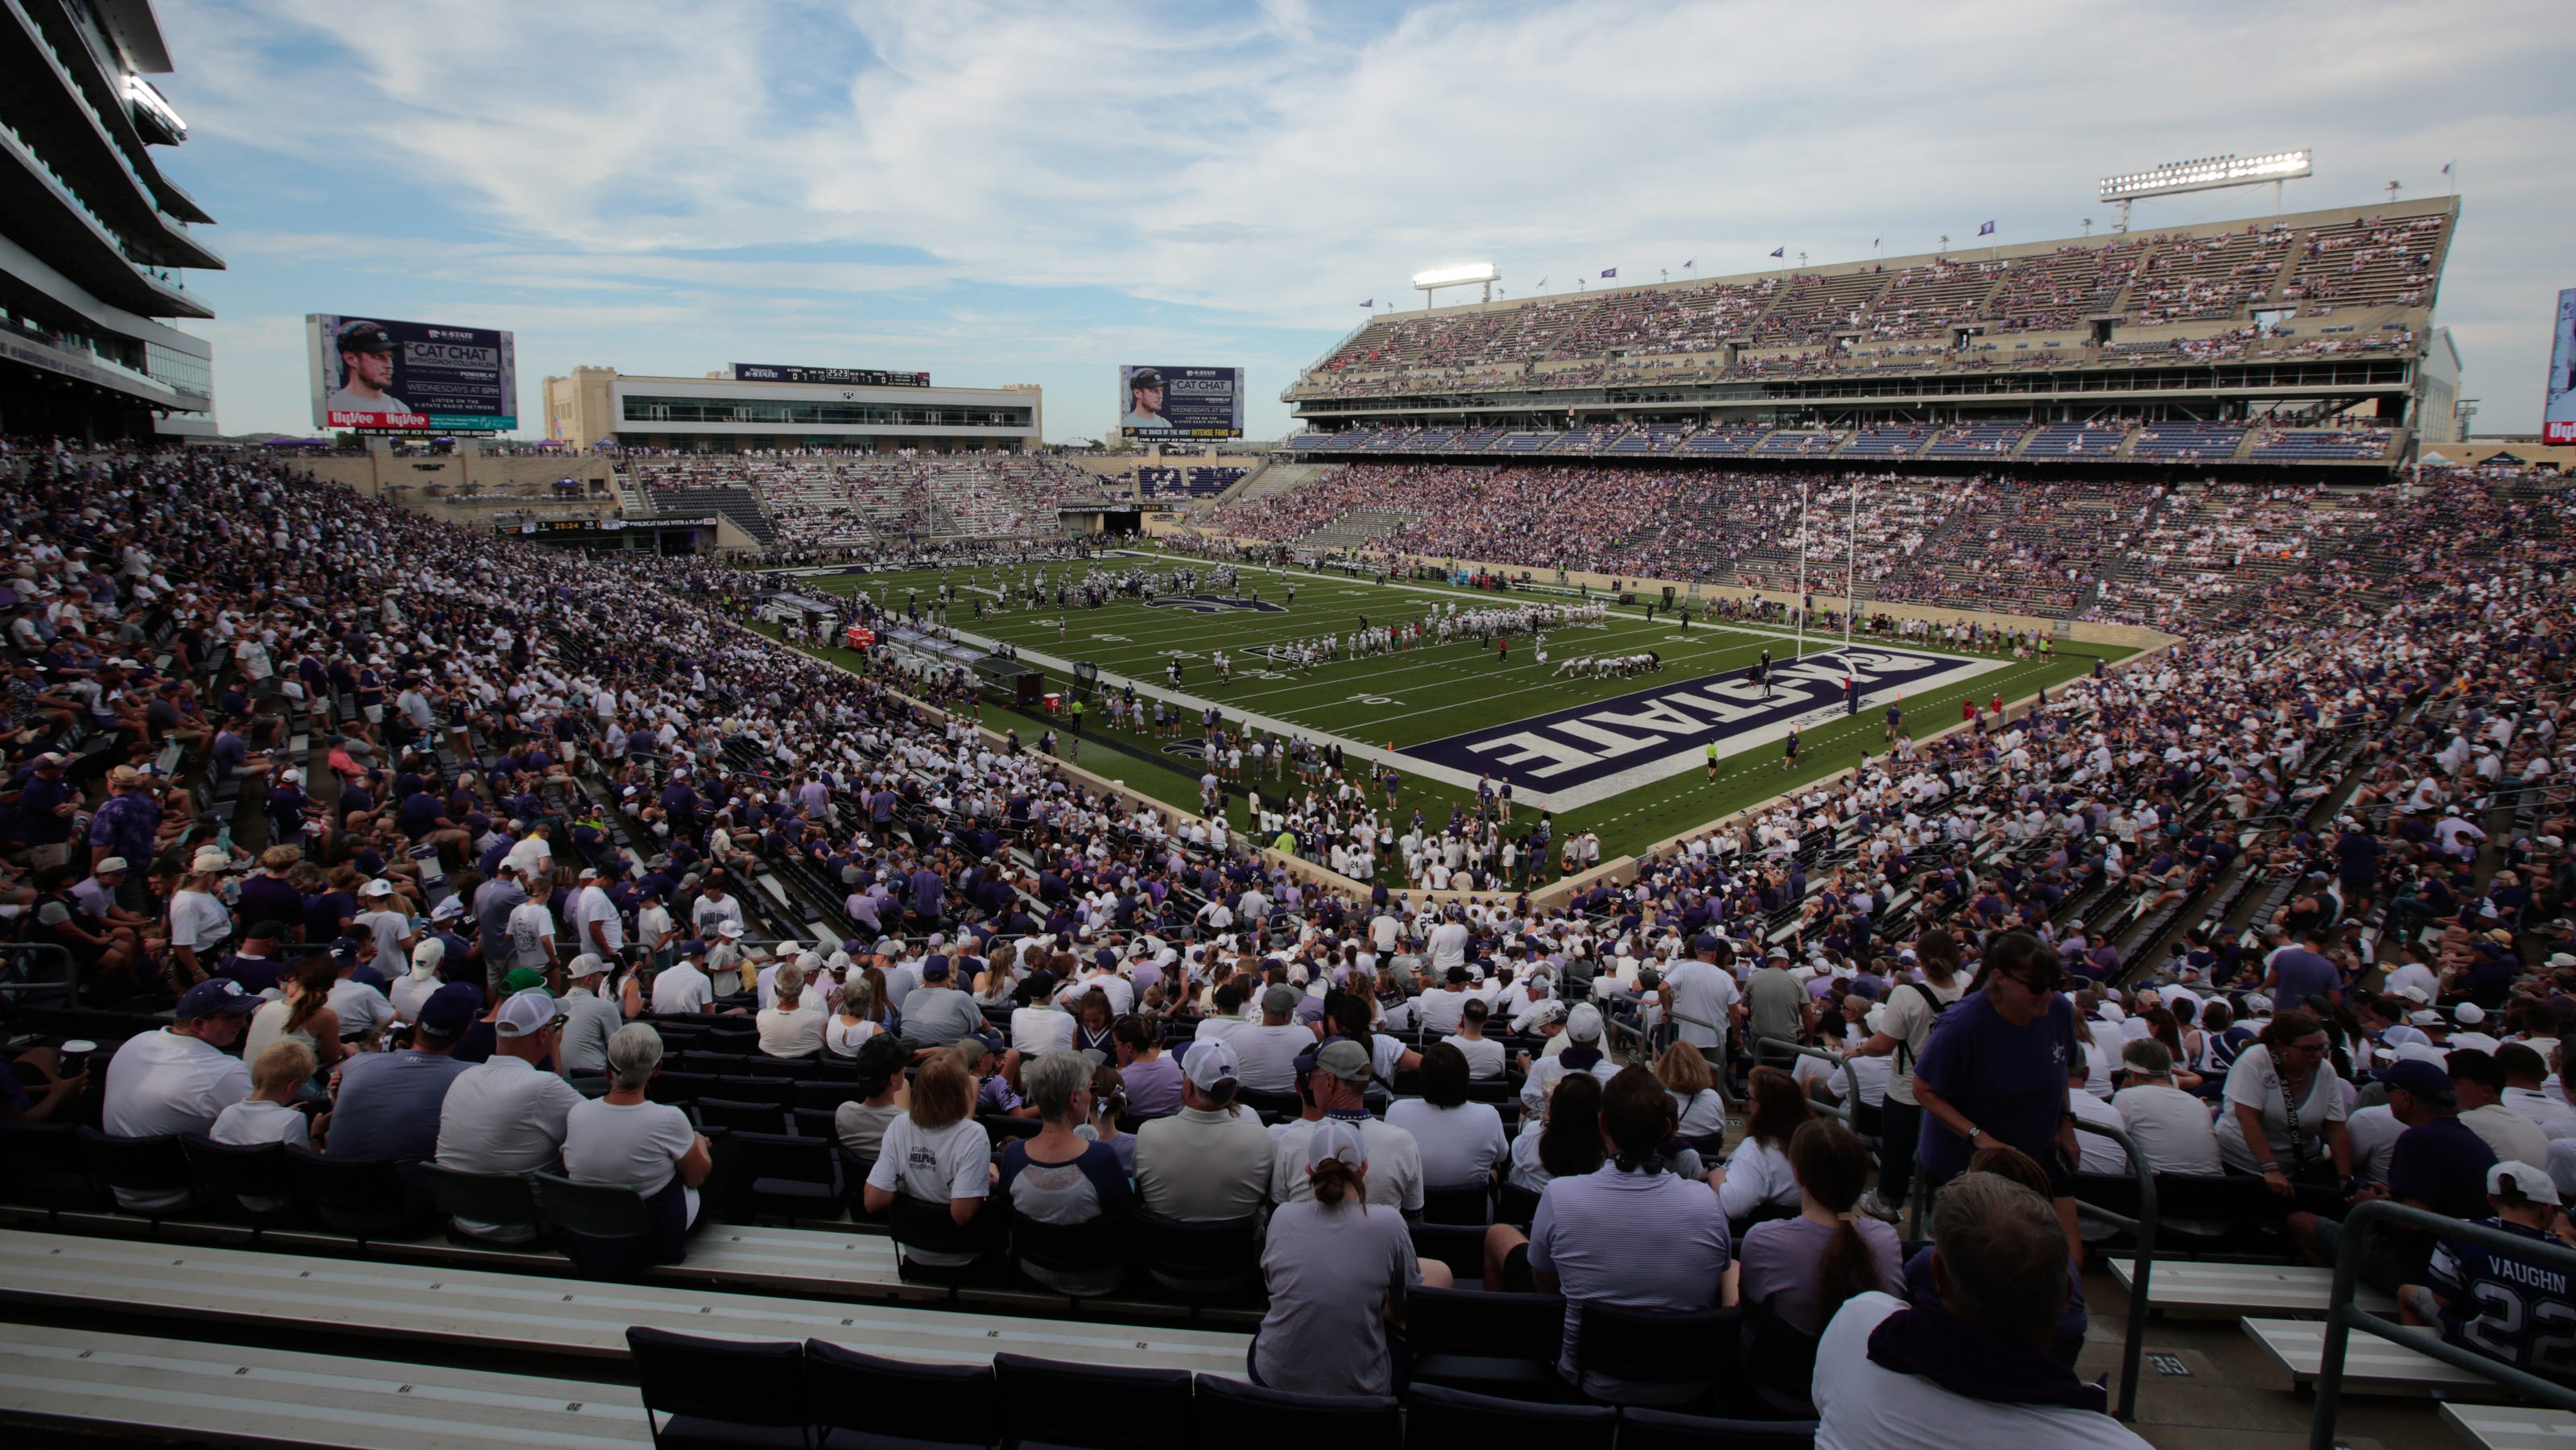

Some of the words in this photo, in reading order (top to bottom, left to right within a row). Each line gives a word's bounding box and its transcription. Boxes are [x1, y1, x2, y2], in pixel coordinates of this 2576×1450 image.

[441, 330, 473, 339] K-STATE
[415, 344, 445, 357] CAT
[448, 347, 489, 361] CHAT
[407, 383, 469, 393] WEDNESDAYS
[1177, 381, 1196, 389] CAT
[1199, 382, 1225, 390] CHAT
[2549, 423, 2576, 441] Hy
[1236, 669, 1286, 680] 20
[1051, 699, 1059, 707] G
[1346, 693, 1392, 704] 10
[1465, 663, 1882, 778] K-STATE
[1305, 836, 1312, 845] 3
[1350, 861, 1359, 869] 24
[2281, 1080, 2297, 1127] WILDCATS
[2291, 1130, 2301, 1144] GO
[911, 1146, 935, 1156] studets
[2487, 1254, 2566, 1295] VAUGHN
[2460, 1277, 2576, 1374] 22
